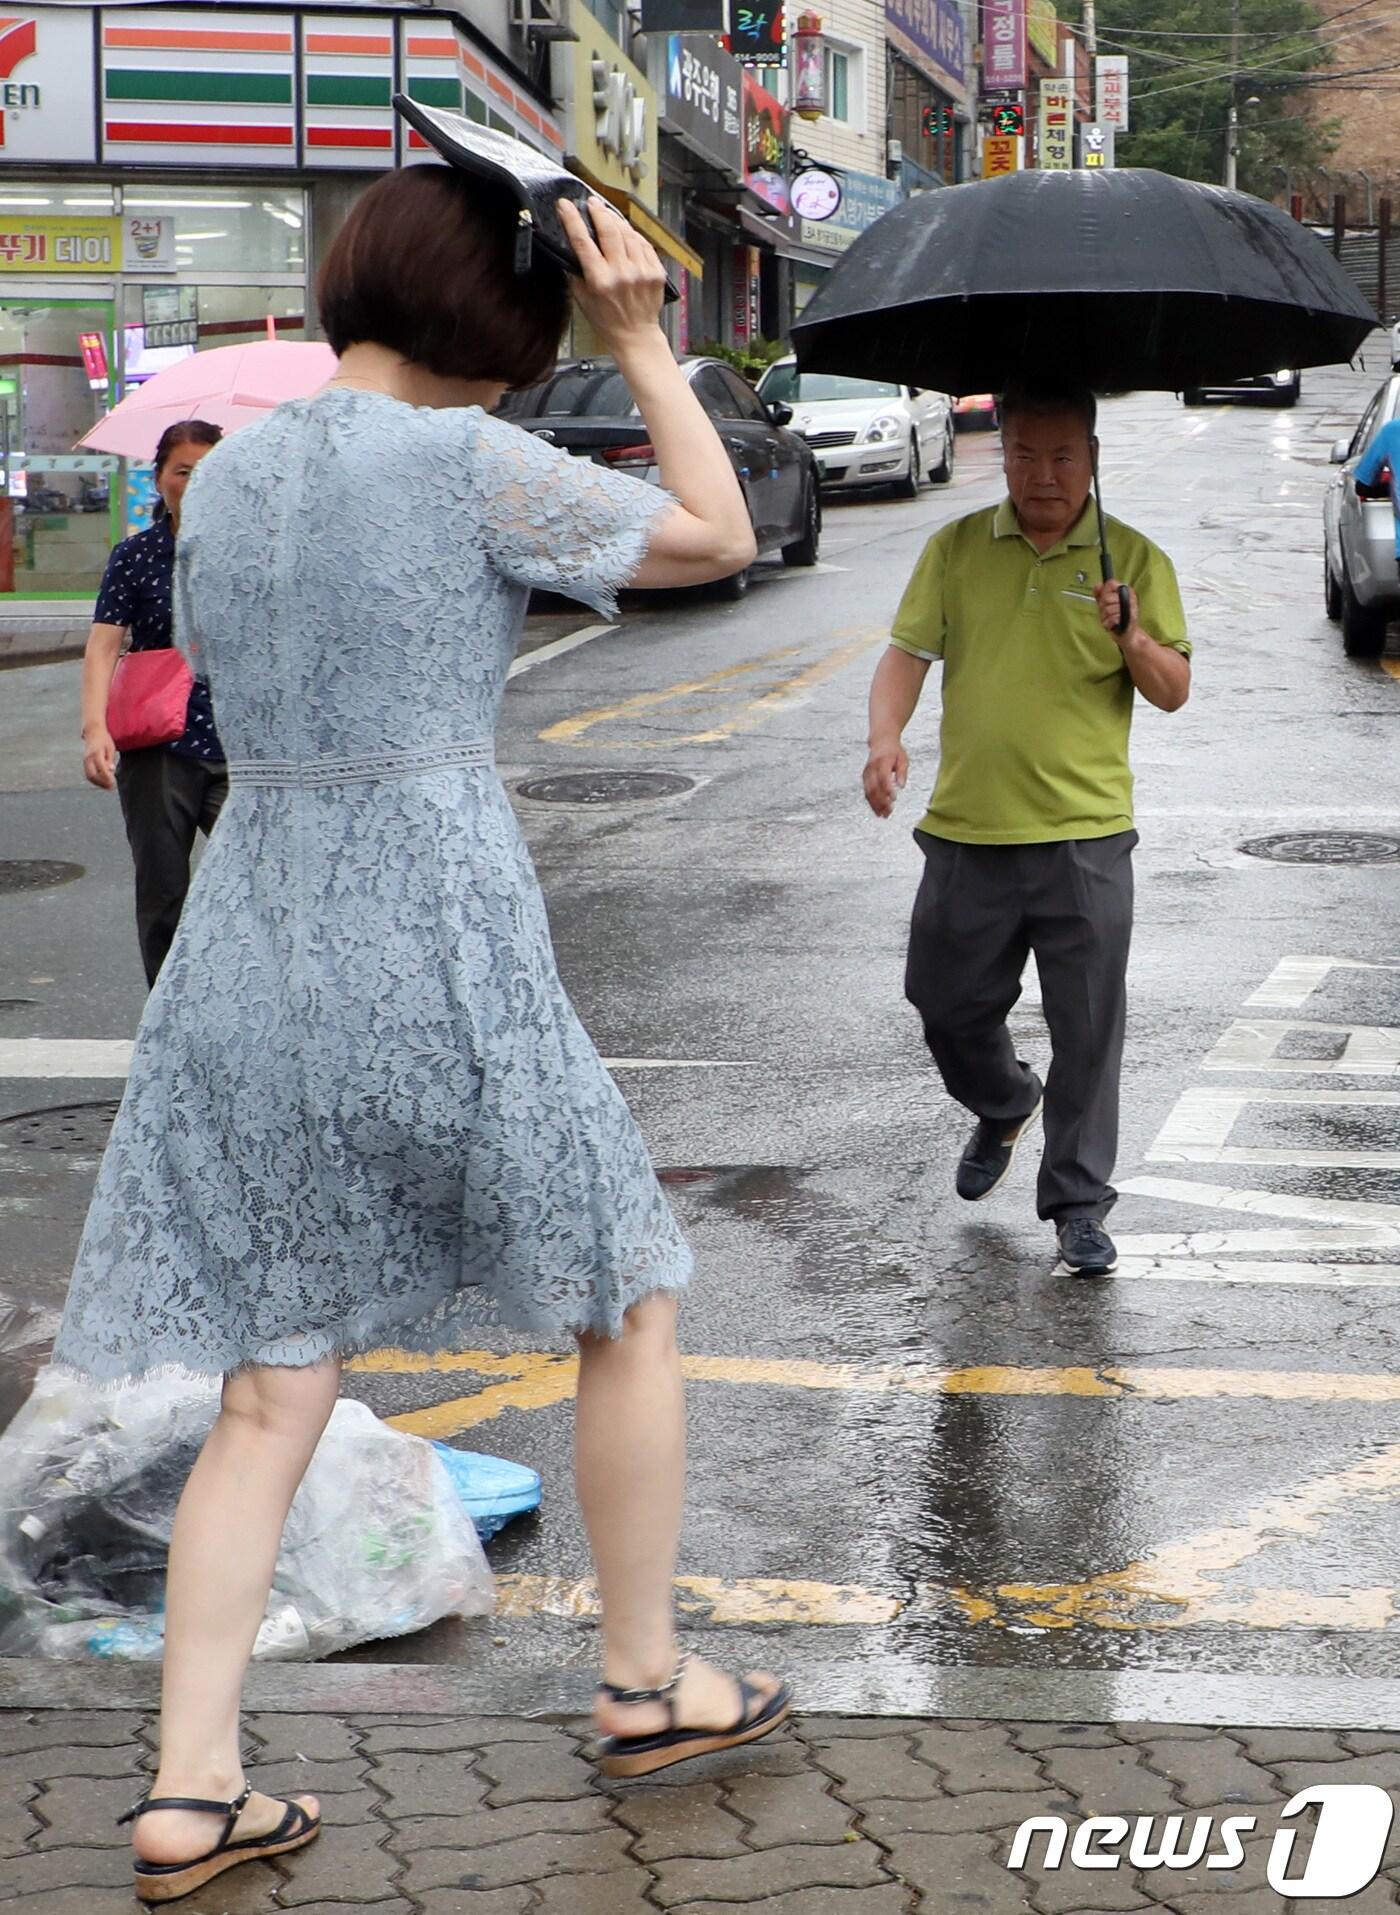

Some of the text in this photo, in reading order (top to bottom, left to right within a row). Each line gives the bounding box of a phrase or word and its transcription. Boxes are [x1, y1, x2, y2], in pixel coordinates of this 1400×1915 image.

[682, 48, 720, 122] 광주은행
[131, 220, 161, 236] 2+1
[55, 236, 111, 264] 데이
